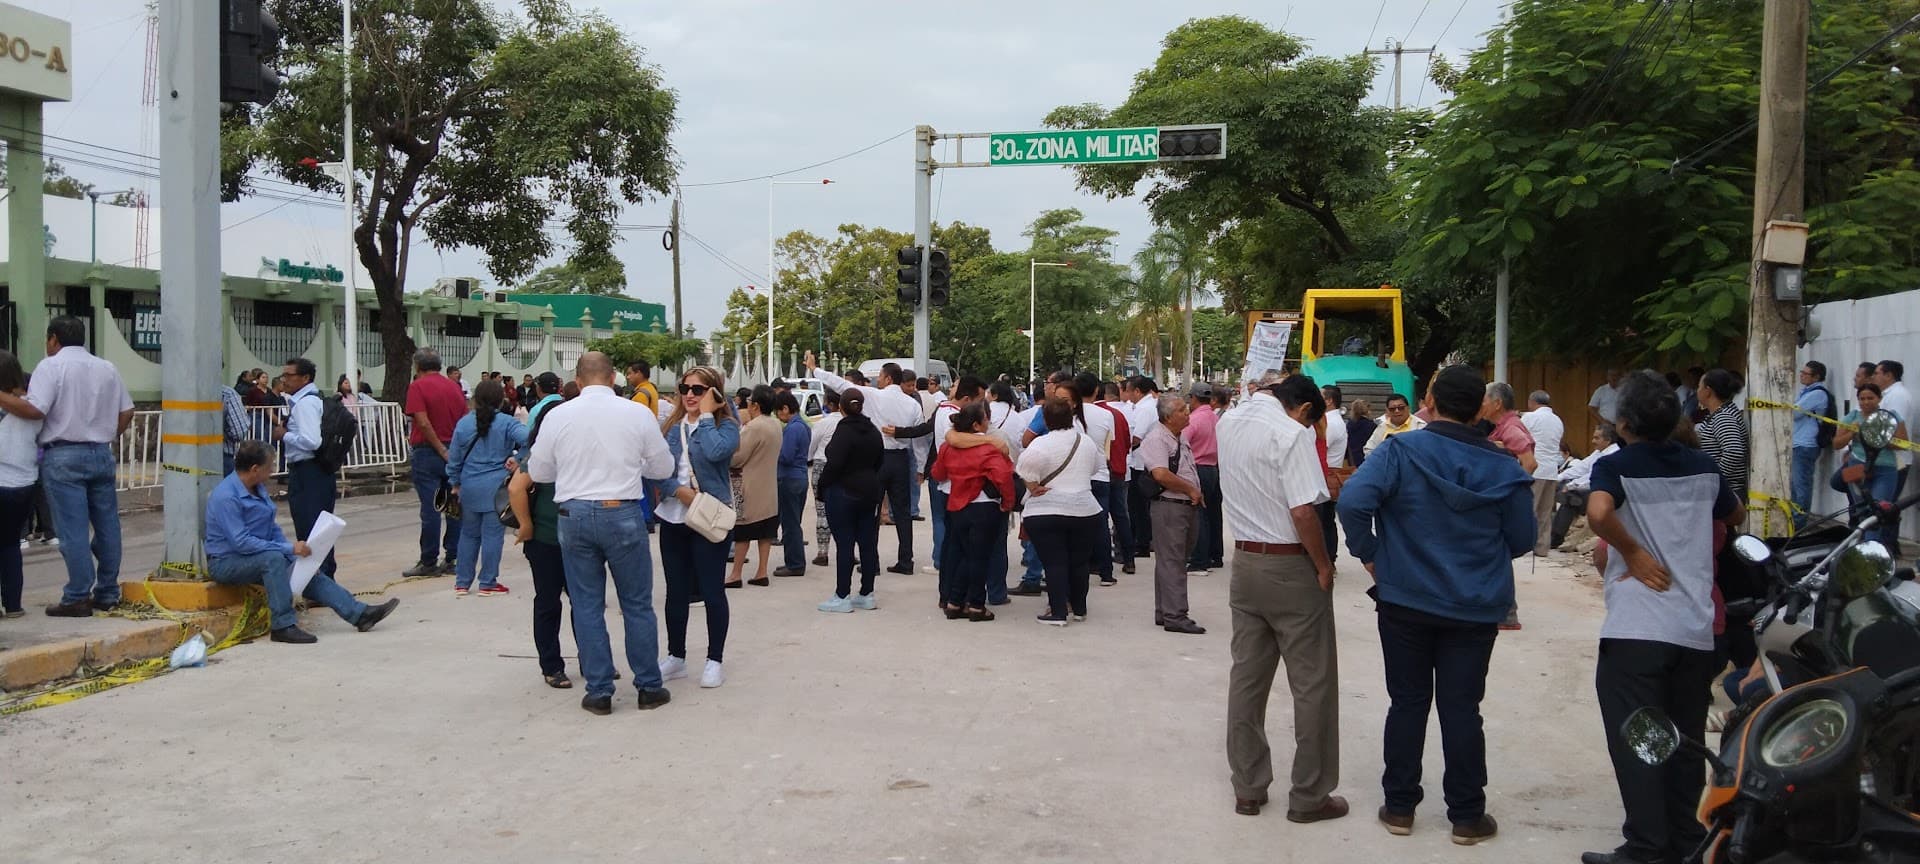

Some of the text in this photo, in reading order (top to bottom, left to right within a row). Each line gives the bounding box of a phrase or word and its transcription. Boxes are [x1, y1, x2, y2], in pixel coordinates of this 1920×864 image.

[1025, 136, 1079, 160] ZONA
[1085, 133, 1157, 158] MILITAR
[135, 309, 162, 332] EJÉR
[137, 333, 162, 345] MEXI
